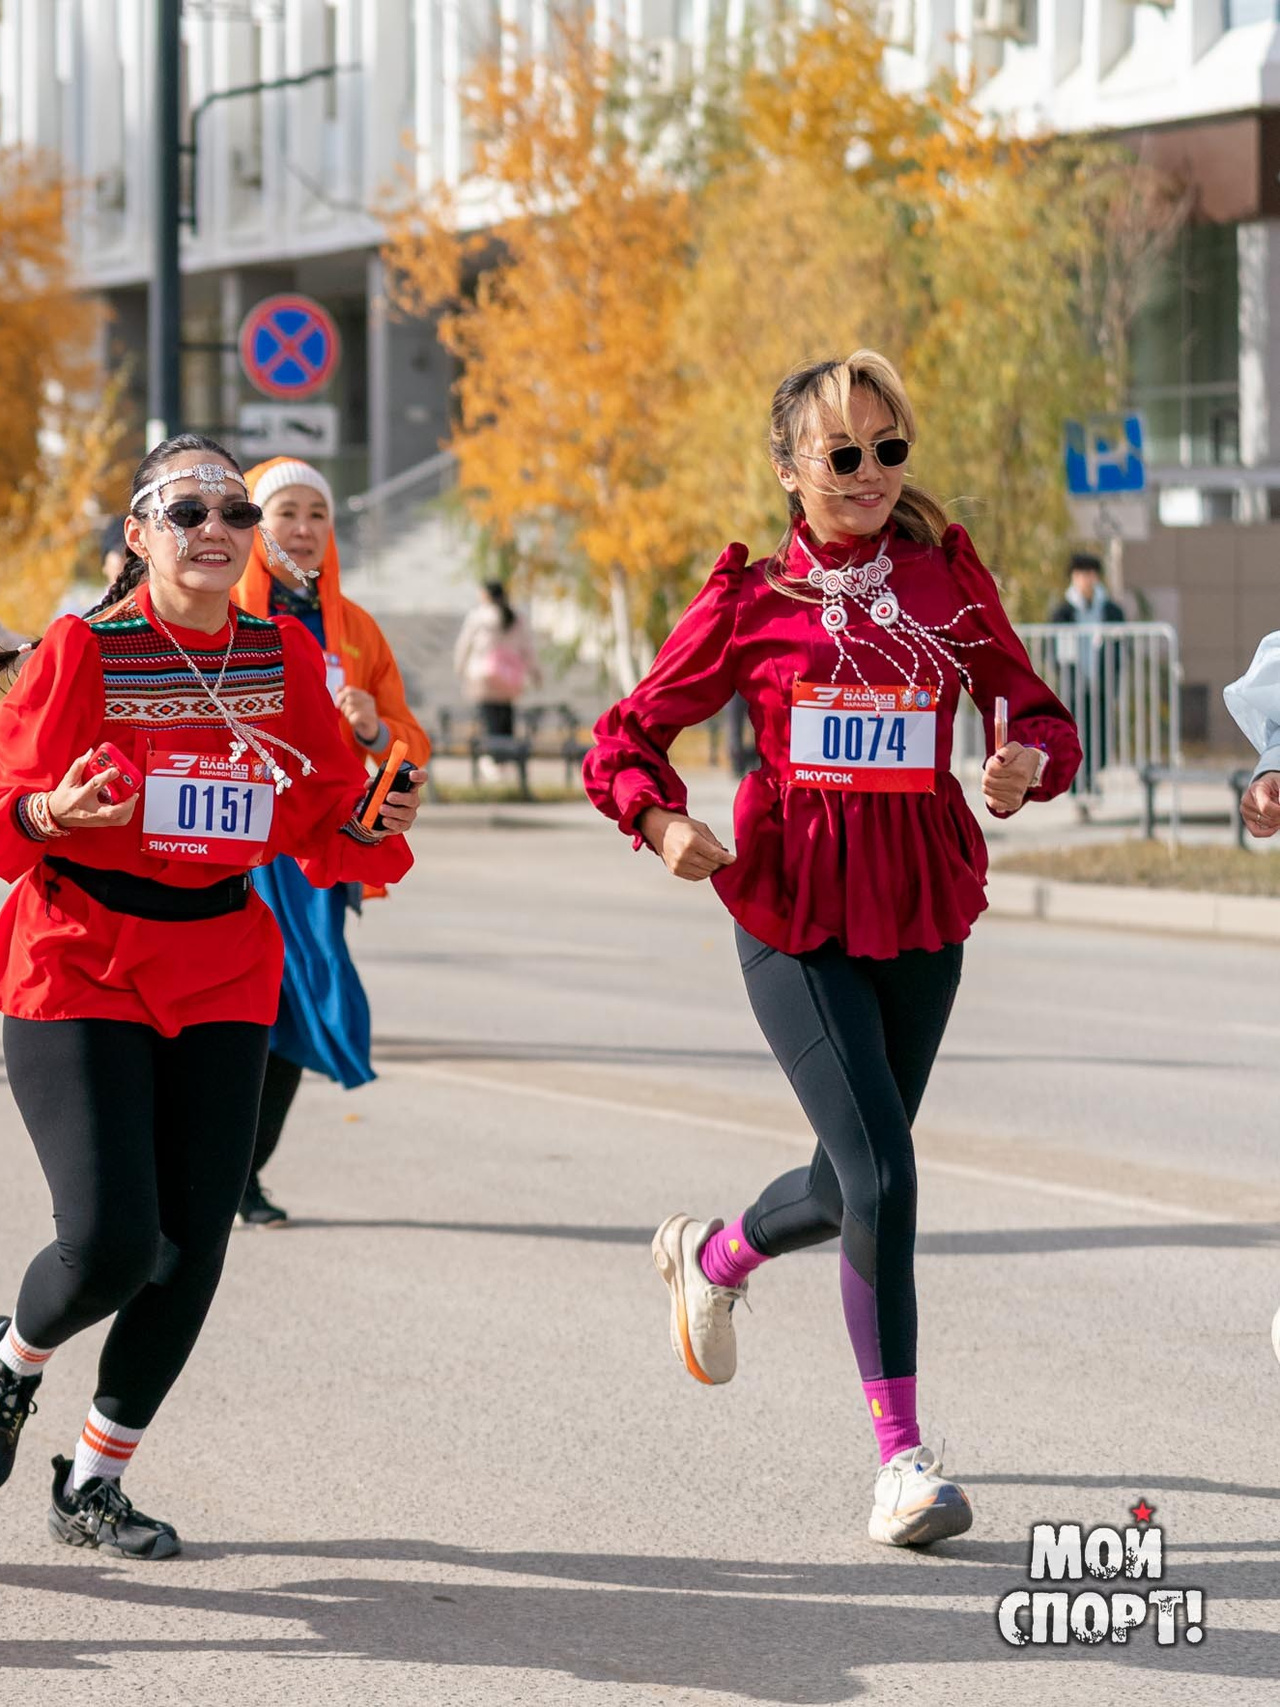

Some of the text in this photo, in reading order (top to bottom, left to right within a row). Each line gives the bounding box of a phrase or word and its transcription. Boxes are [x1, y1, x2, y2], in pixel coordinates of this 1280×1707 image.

[822, 715, 907, 763] 0074
[199, 755, 230, 763] ЗАБЕ
[199, 761, 249, 772] ОЛОНХО
[794, 769, 853, 785] ЯКУТСК
[178, 784, 253, 834] 0151
[148, 840, 209, 855] ЯКУТСК
